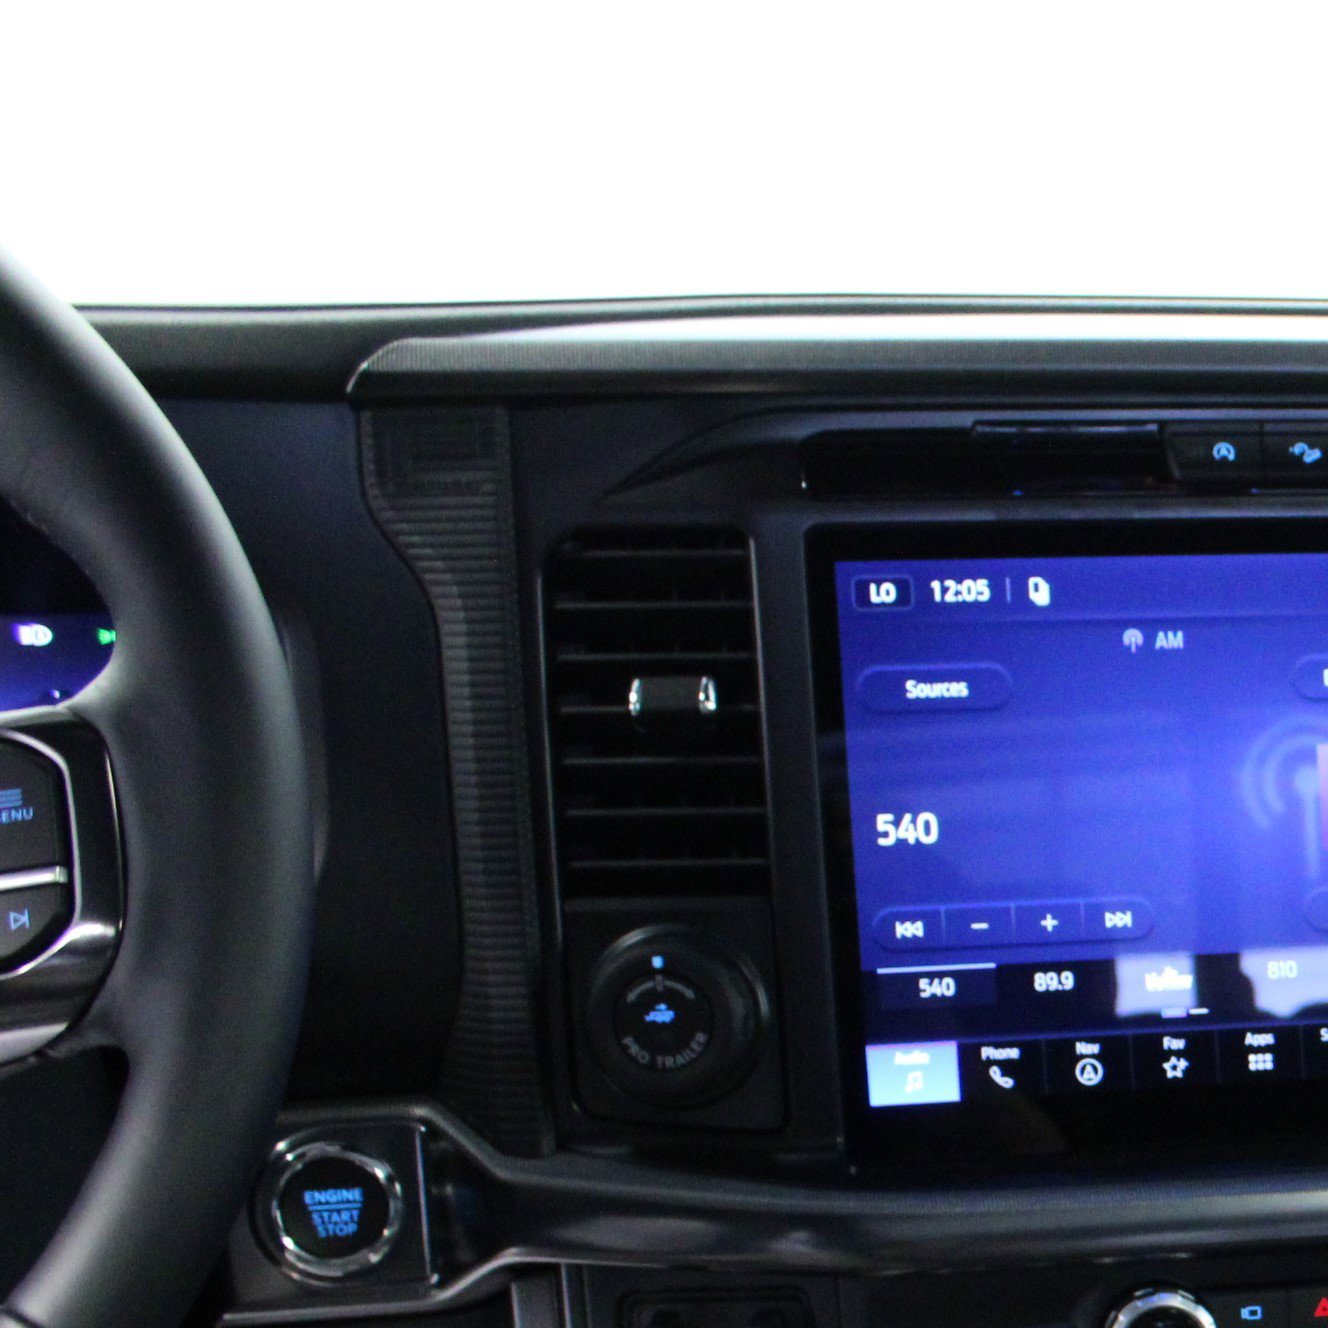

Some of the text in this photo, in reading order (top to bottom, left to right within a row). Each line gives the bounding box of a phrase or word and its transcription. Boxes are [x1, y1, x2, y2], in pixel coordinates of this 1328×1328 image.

[868, 578, 991, 604] LO 12:05
[1154, 630, 1184, 650] AM
[904, 679, 969, 699] Sources
[0, 806, 33, 825] ENU
[875, 811, 940, 847] 540
[917, 976, 956, 998] 540
[1033, 970, 1074, 992] 89.9
[1266, 958, 1298, 979] 810
[980, 1044, 1020, 1061] Phone
[1075, 1040, 1100, 1056] Nav
[1162, 1035, 1185, 1052] Fav
[1243, 1030, 1275, 1048] Apps
[303, 1186, 364, 1205] ENGINE
[311, 1208, 361, 1225] START
[316, 1222, 358, 1238] STOP
